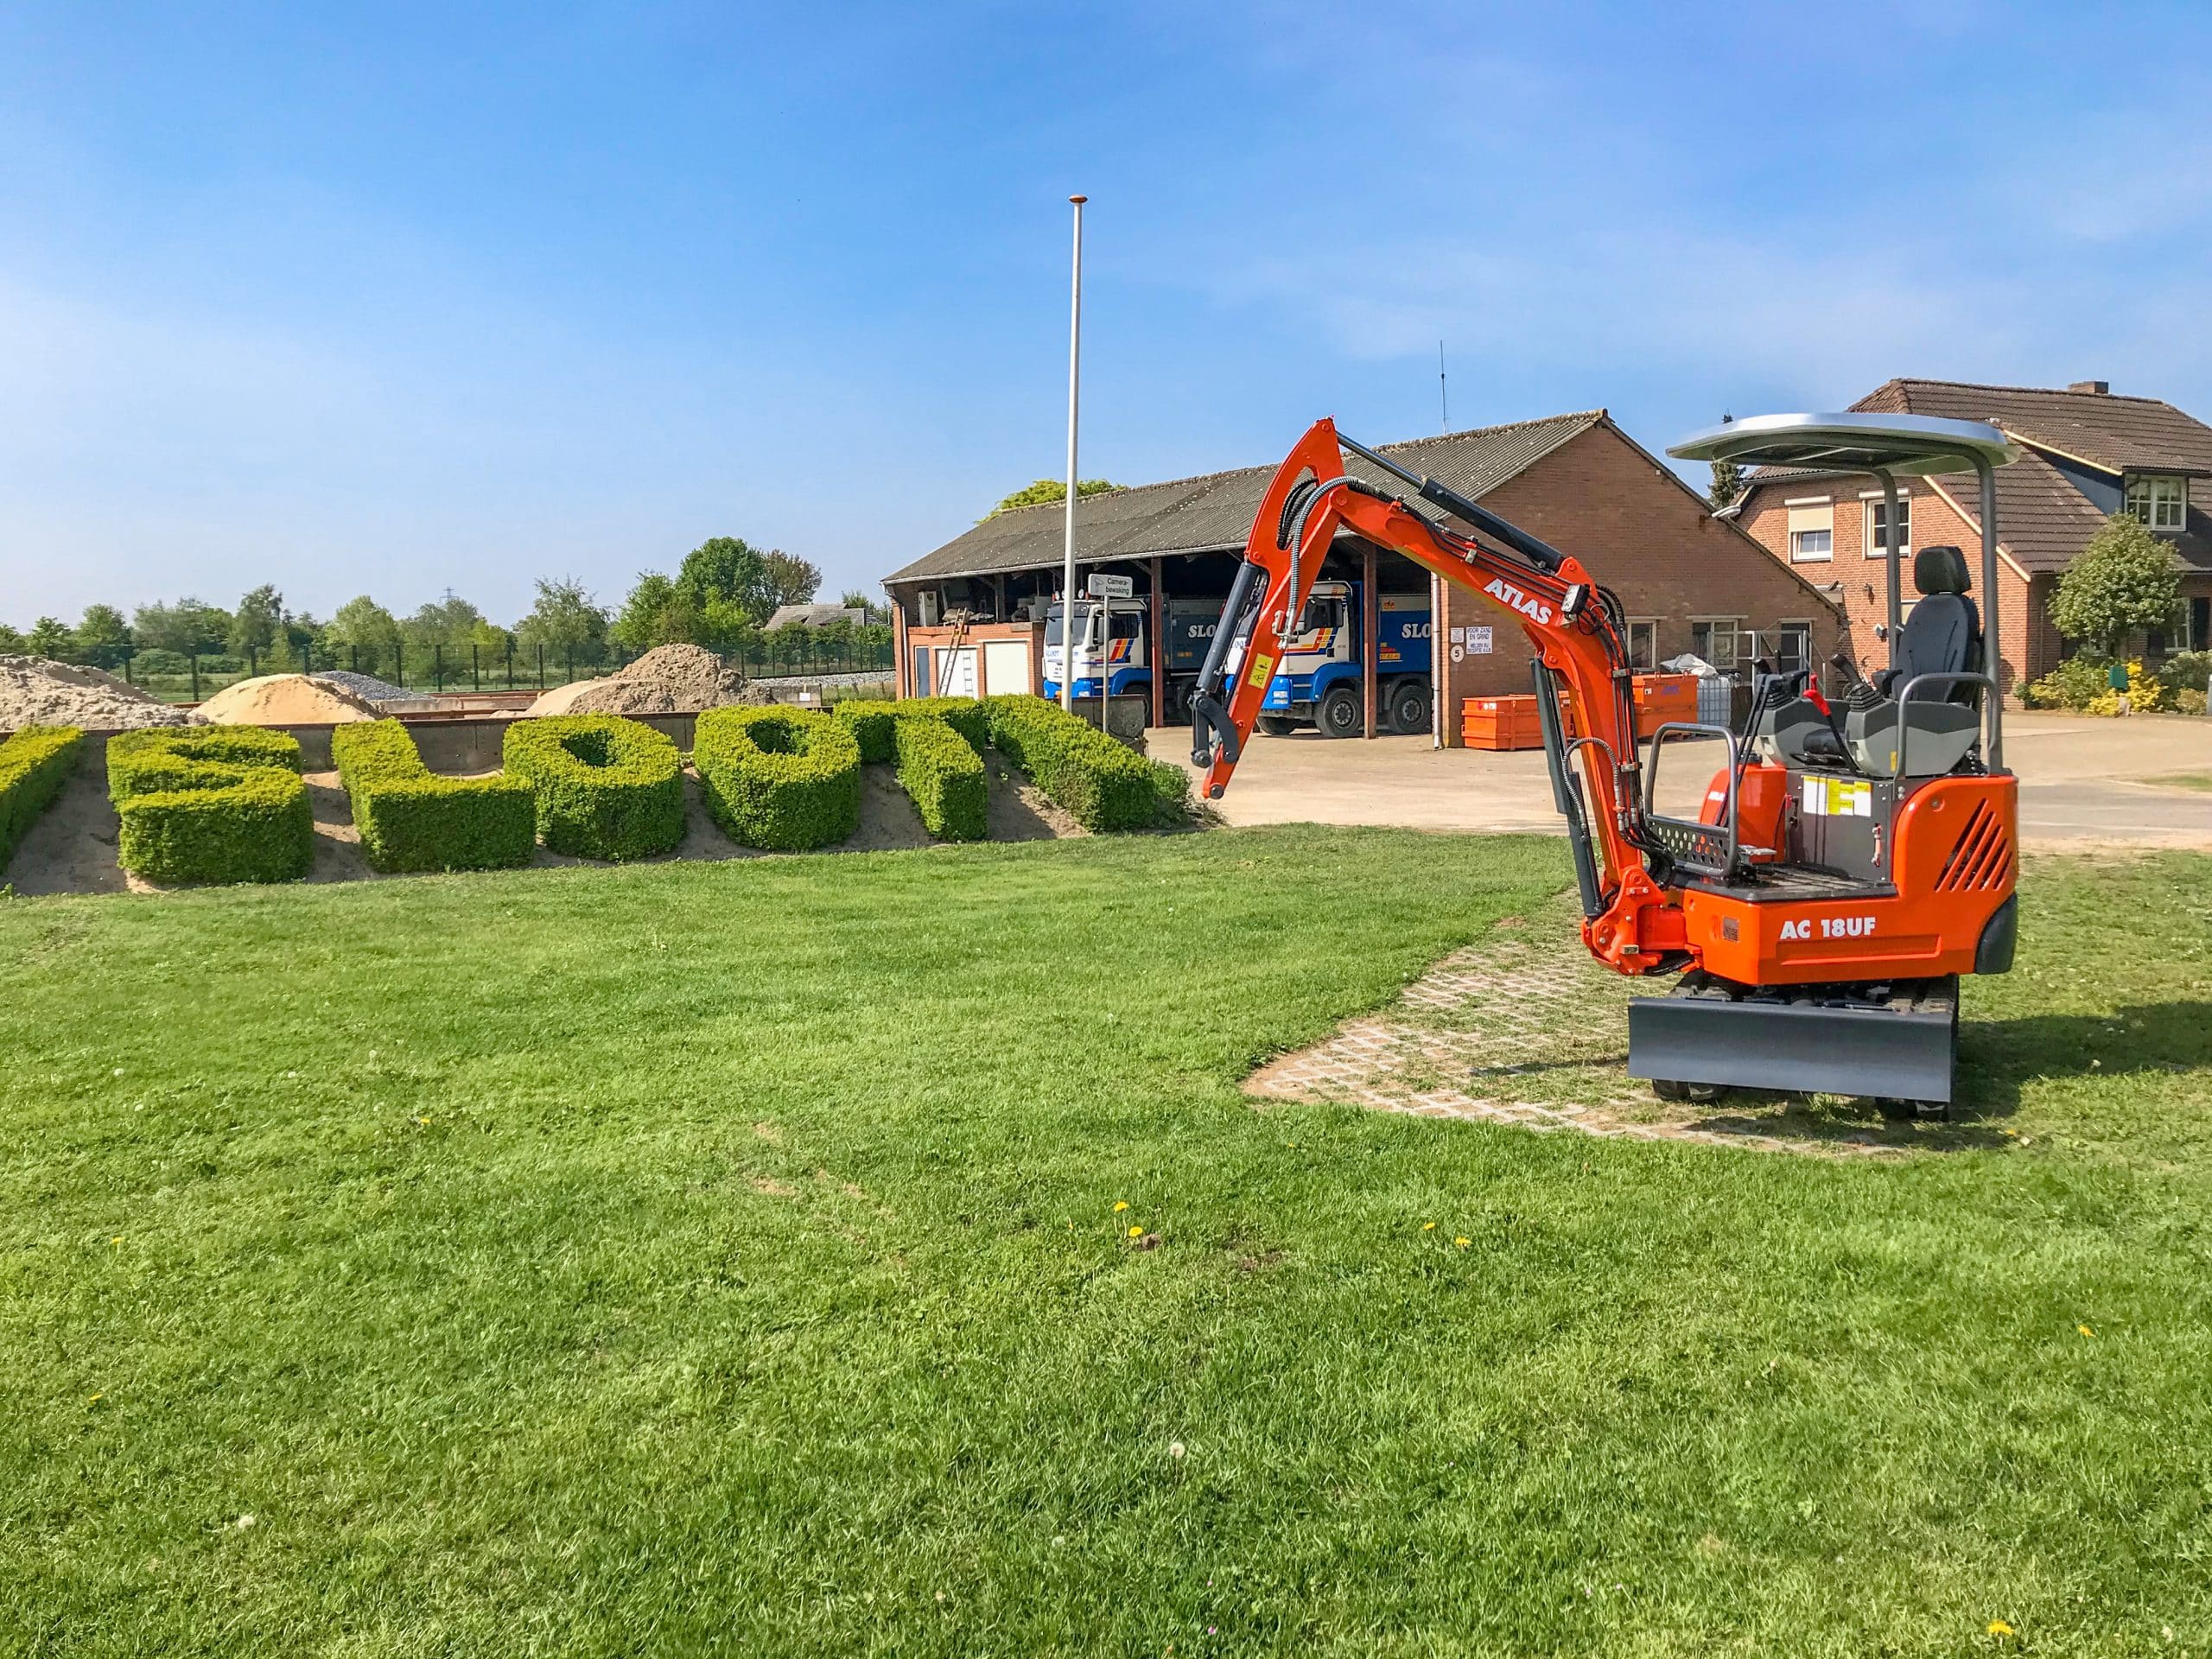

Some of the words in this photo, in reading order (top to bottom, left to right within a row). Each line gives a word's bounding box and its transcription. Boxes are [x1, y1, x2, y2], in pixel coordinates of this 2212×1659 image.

[1483, 577, 1553, 625] ATLAS
[1780, 919, 1811, 940] AC
[1820, 917, 1876, 938] 18UF
